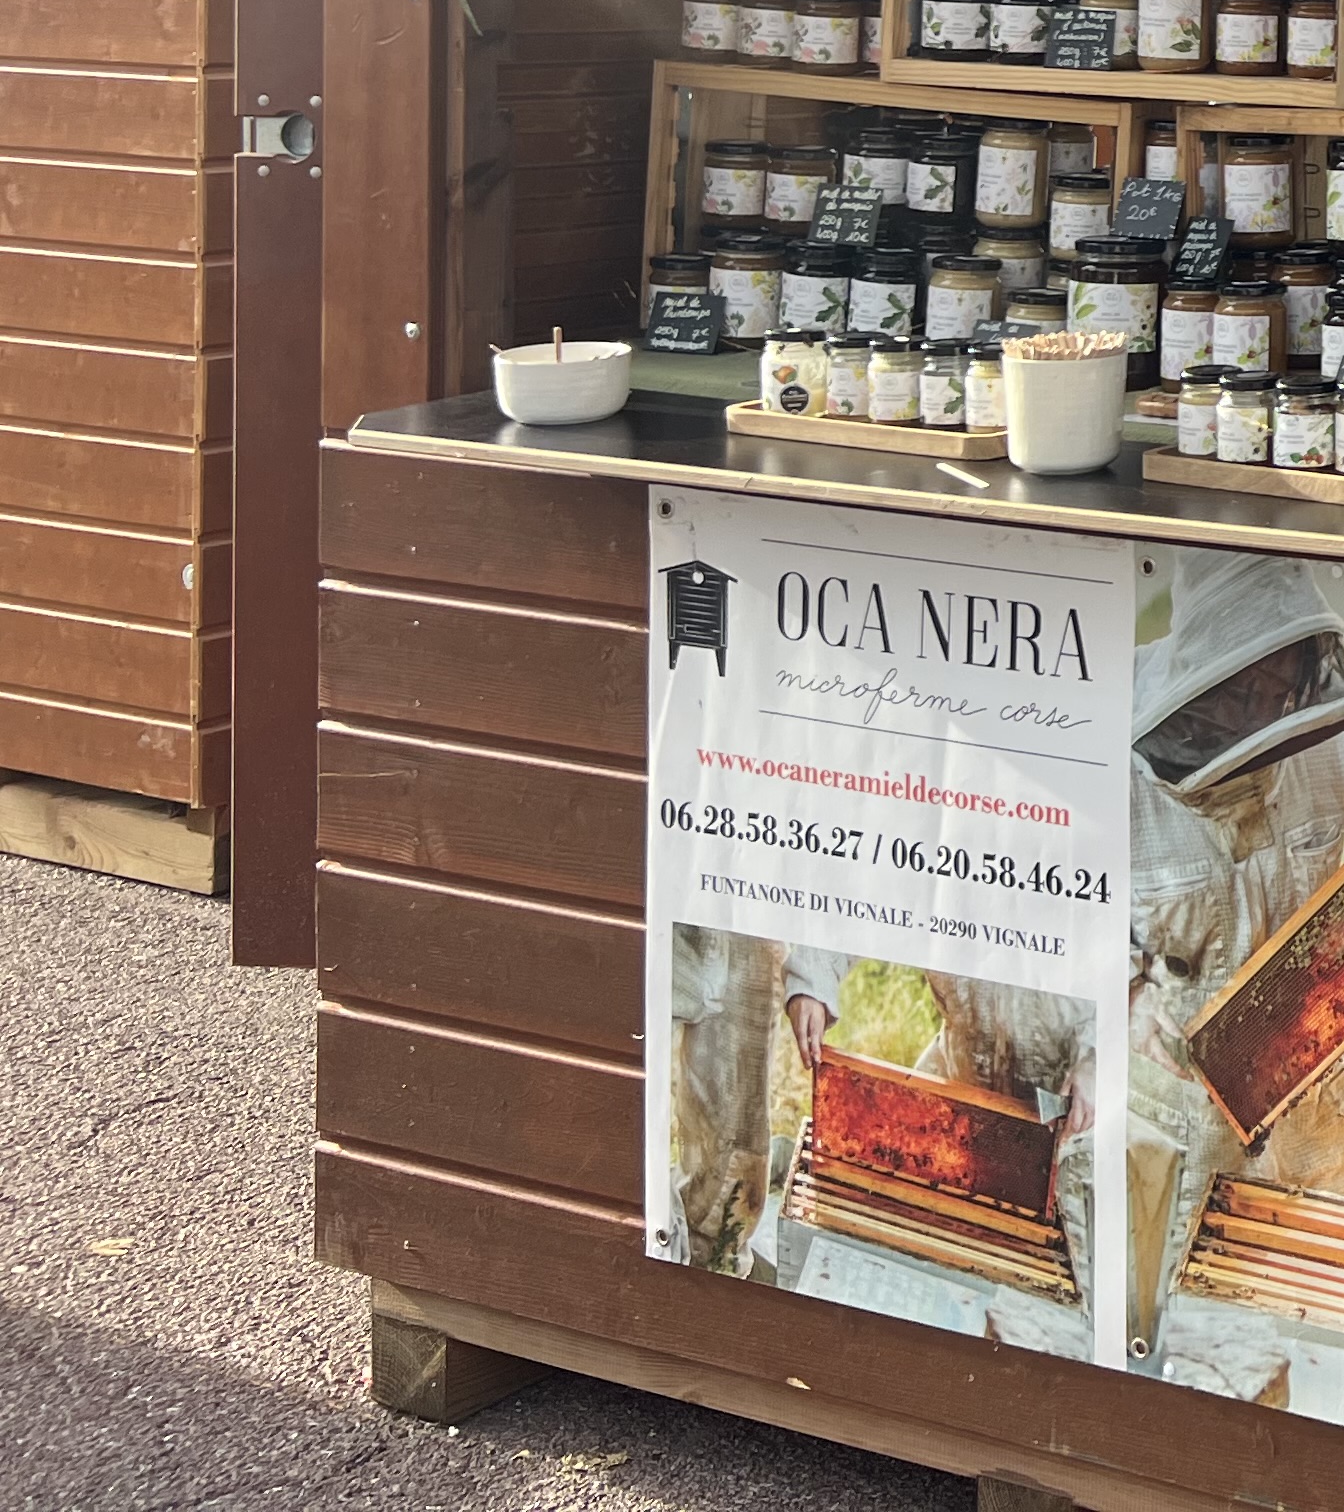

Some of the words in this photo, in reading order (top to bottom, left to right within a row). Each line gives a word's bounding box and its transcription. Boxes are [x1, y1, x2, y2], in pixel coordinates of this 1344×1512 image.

[1126, 205, 1157, 220] 20€
[776, 571, 895, 656] OCA
[916, 588, 1094, 682] NERA
[776, 668, 987, 725] microferme
[999, 702, 1093, 730] corse
[697, 747, 1071, 827] www.ocaneramieldecorse.com
[661, 798, 863, 862] 06.28.58.36.27
[891, 837, 1112, 905] 06.20.58.46.24
[700, 873, 806, 910] FUNTANONE
[809, 892, 829, 914] DI
[834, 898, 914, 929] VIGNALE
[929, 914, 978, 941] 20290
[981, 925, 1066, 957] VIGNALE
